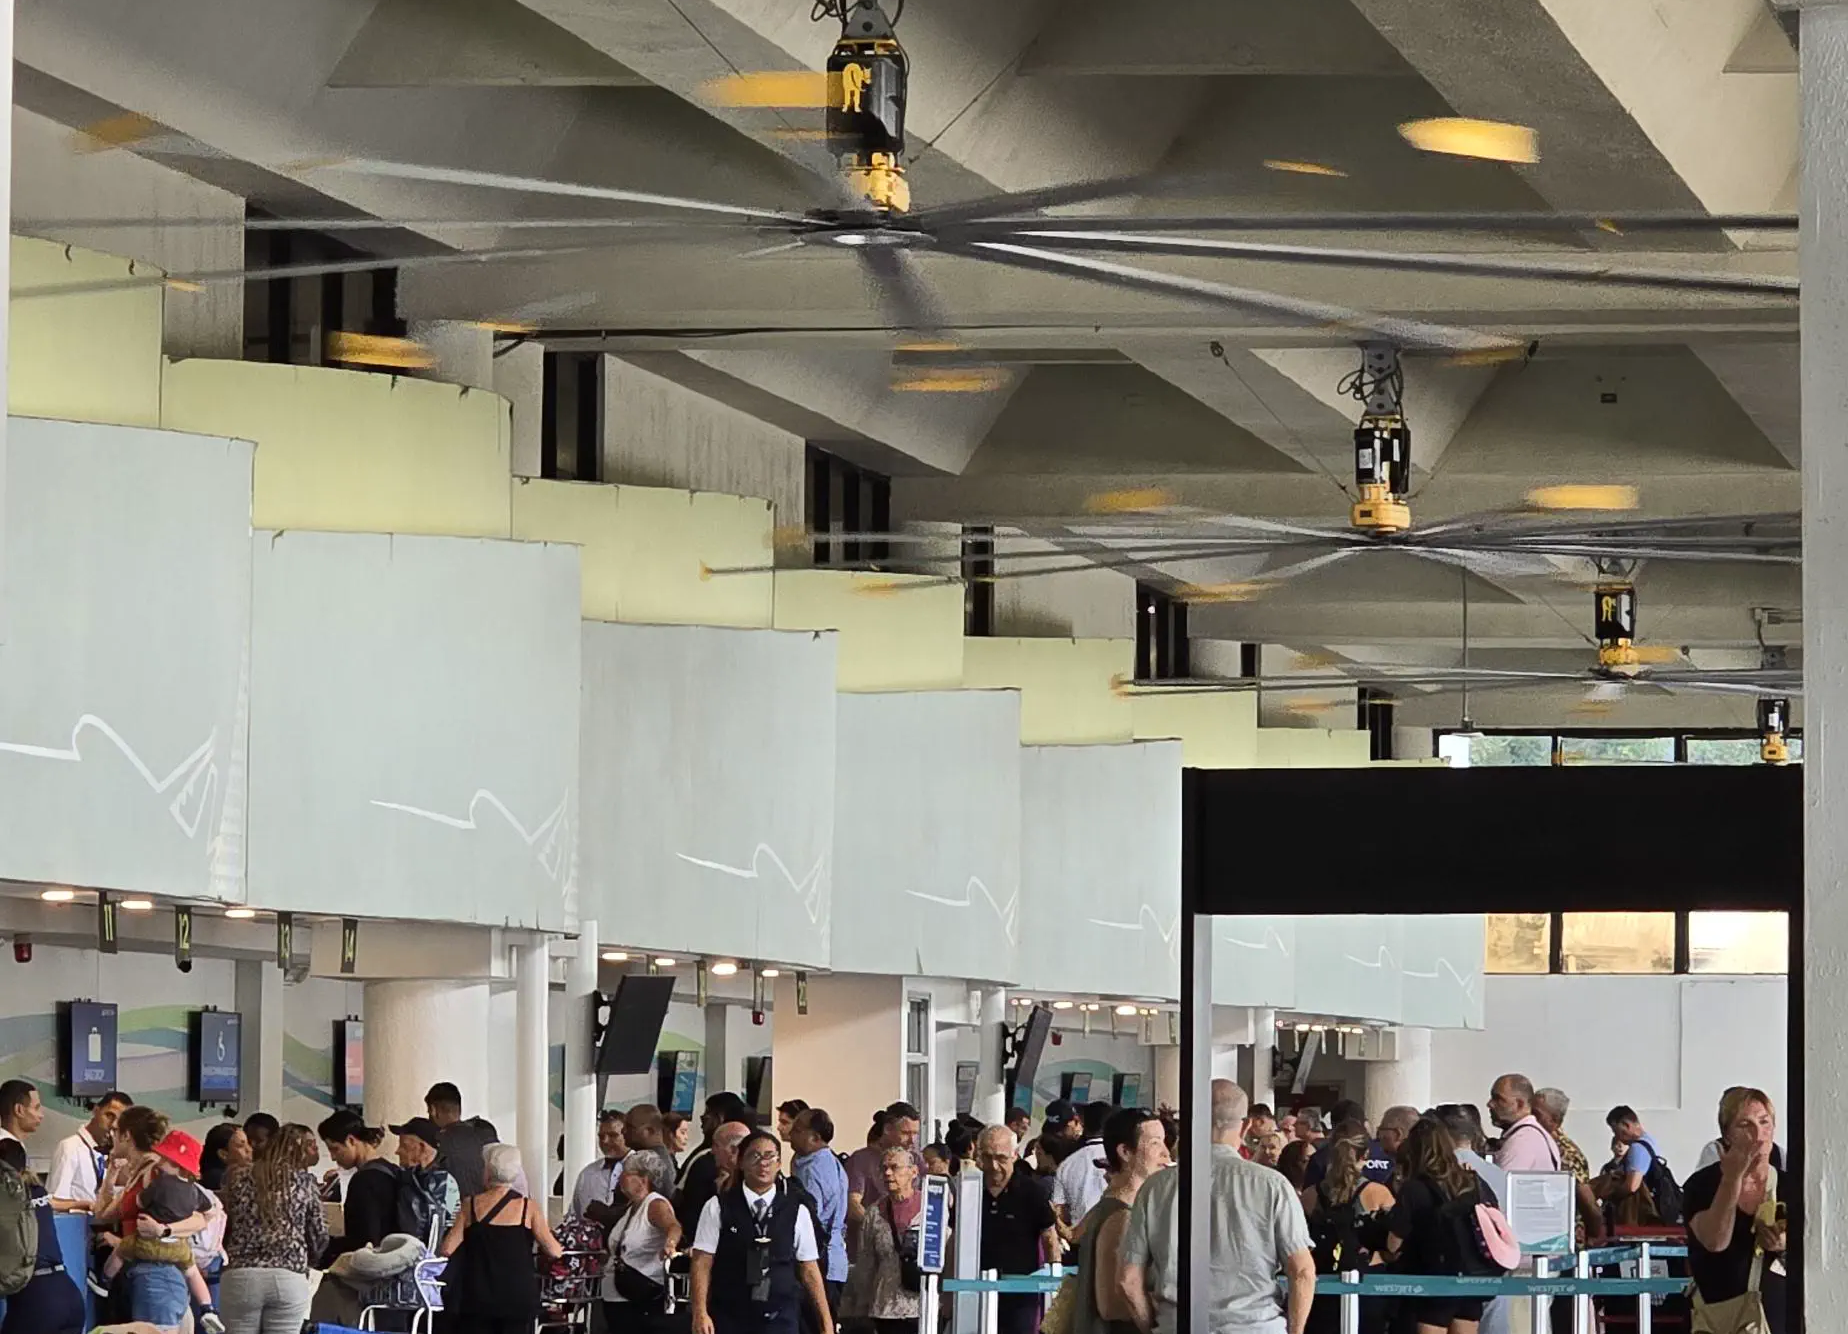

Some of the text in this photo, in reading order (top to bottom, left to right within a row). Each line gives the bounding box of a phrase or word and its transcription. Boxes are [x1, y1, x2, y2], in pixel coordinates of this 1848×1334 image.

[104, 904, 114, 941] 11
[178, 913, 190, 949] 12
[280, 923, 290, 960] 13
[345, 929, 355, 963] 14
[1373, 1284, 1412, 1294] WESTJET
